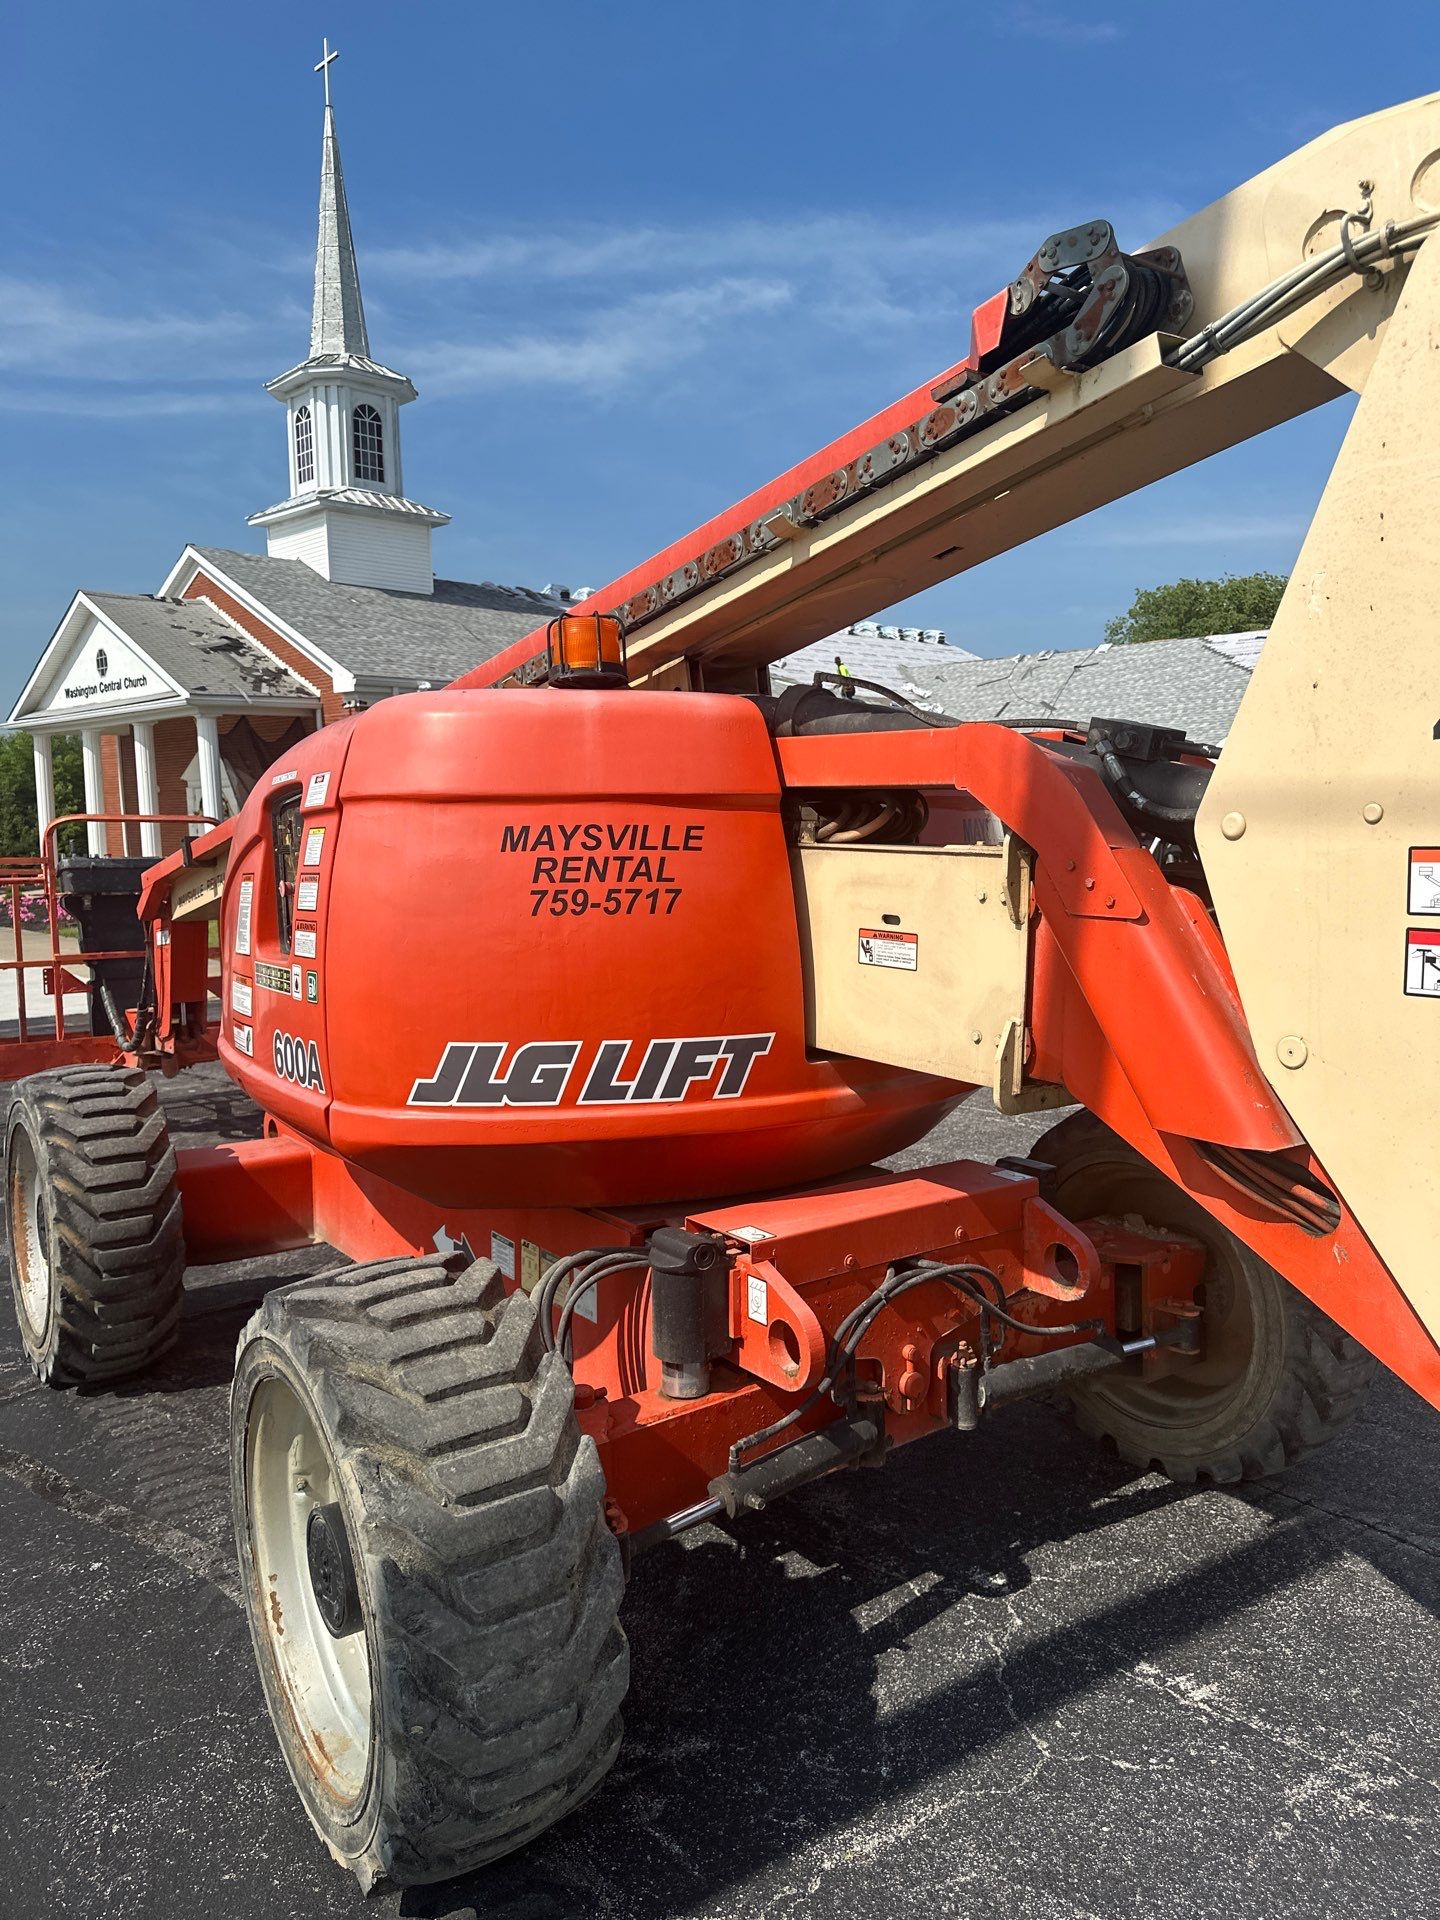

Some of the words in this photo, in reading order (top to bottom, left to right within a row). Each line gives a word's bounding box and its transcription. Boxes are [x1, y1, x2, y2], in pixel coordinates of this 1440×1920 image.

[65, 685, 98, 699] Washington
[99, 679, 122, 693] Central
[124, 675, 148, 689] Church
[500, 824, 705, 853] MAYSVILLE
[531, 856, 676, 883] RENTAL
[530, 888, 682, 917] 759-5717
[878, 932, 903, 941] WARNING
[273, 1029, 325, 1094] 600A
[406, 1040, 583, 1107] JLG
[576, 1032, 776, 1106] LIFT
